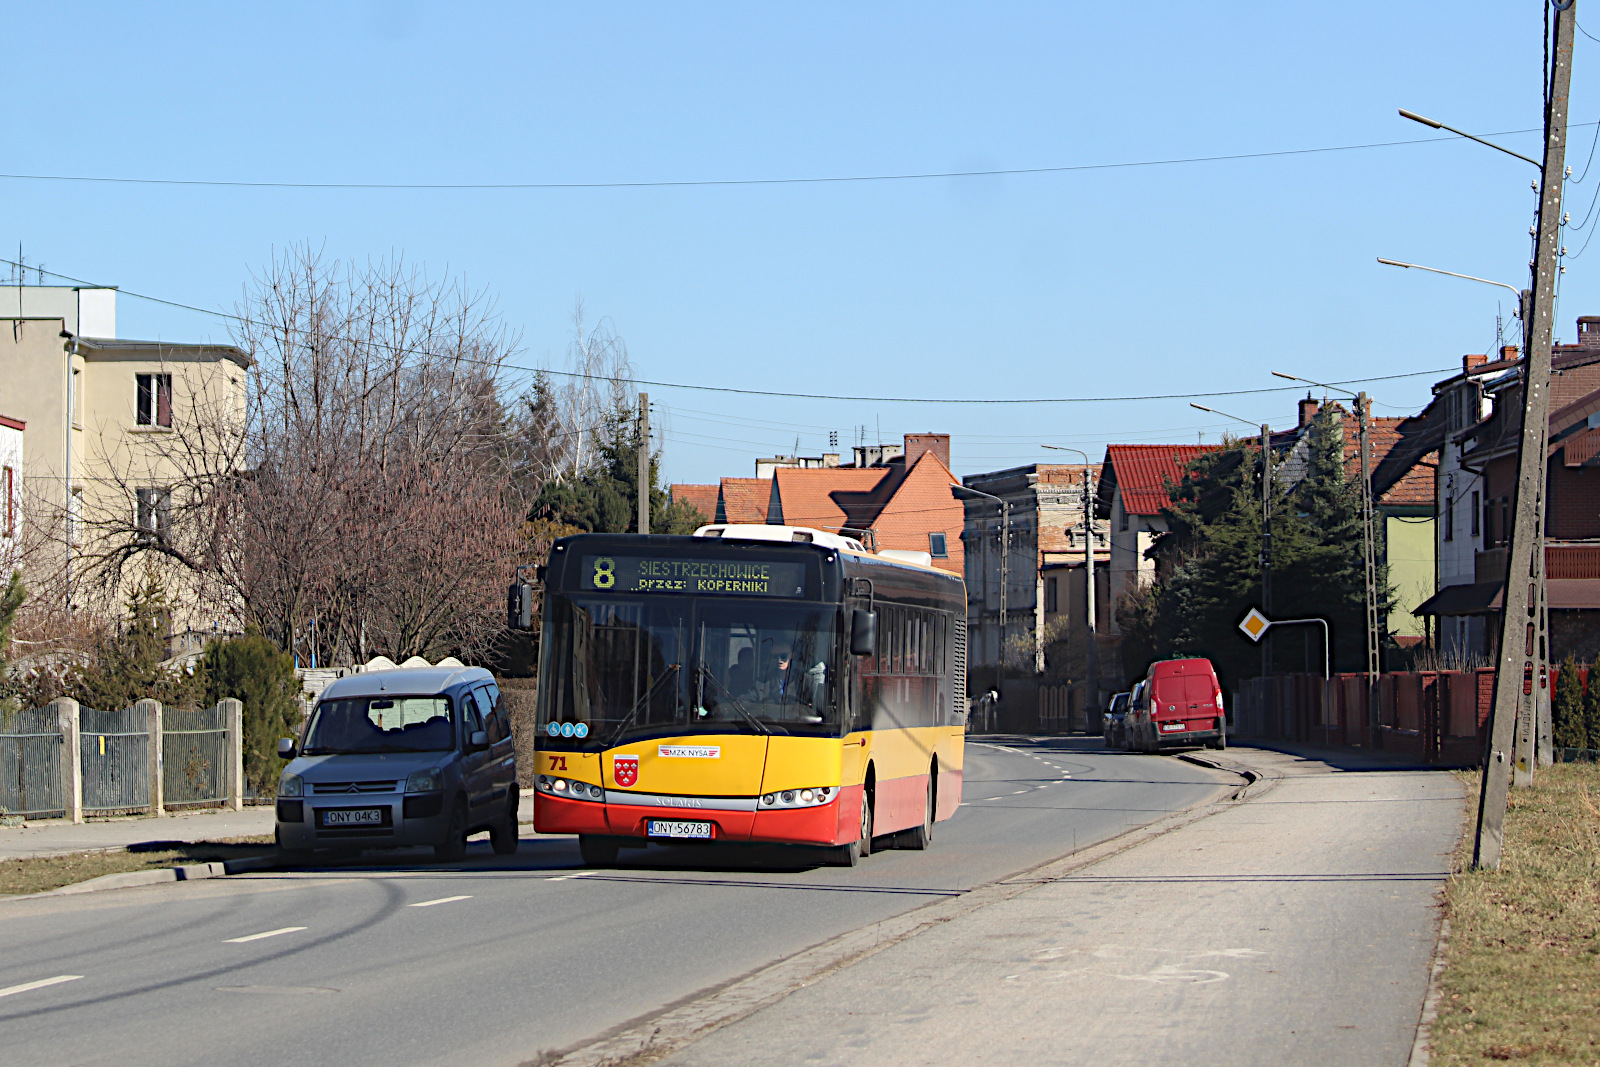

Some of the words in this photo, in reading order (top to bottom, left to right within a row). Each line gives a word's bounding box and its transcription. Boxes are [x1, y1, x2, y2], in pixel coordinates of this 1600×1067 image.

[593, 556, 616, 589] 8
[640, 560, 770, 580] SIESTRZECHOWICE
[697, 579, 768, 593] KOPERNIKI
[669, 749, 687, 757] MZK
[688, 749, 709, 758] NYSA
[548, 755, 568, 771] 71
[655, 796, 703, 808] SOLARIS
[330, 811, 351, 823] ONY
[354, 810, 380, 822] 04K3
[653, 821, 674, 834] ONY
[677, 822, 710, 835] 56783
